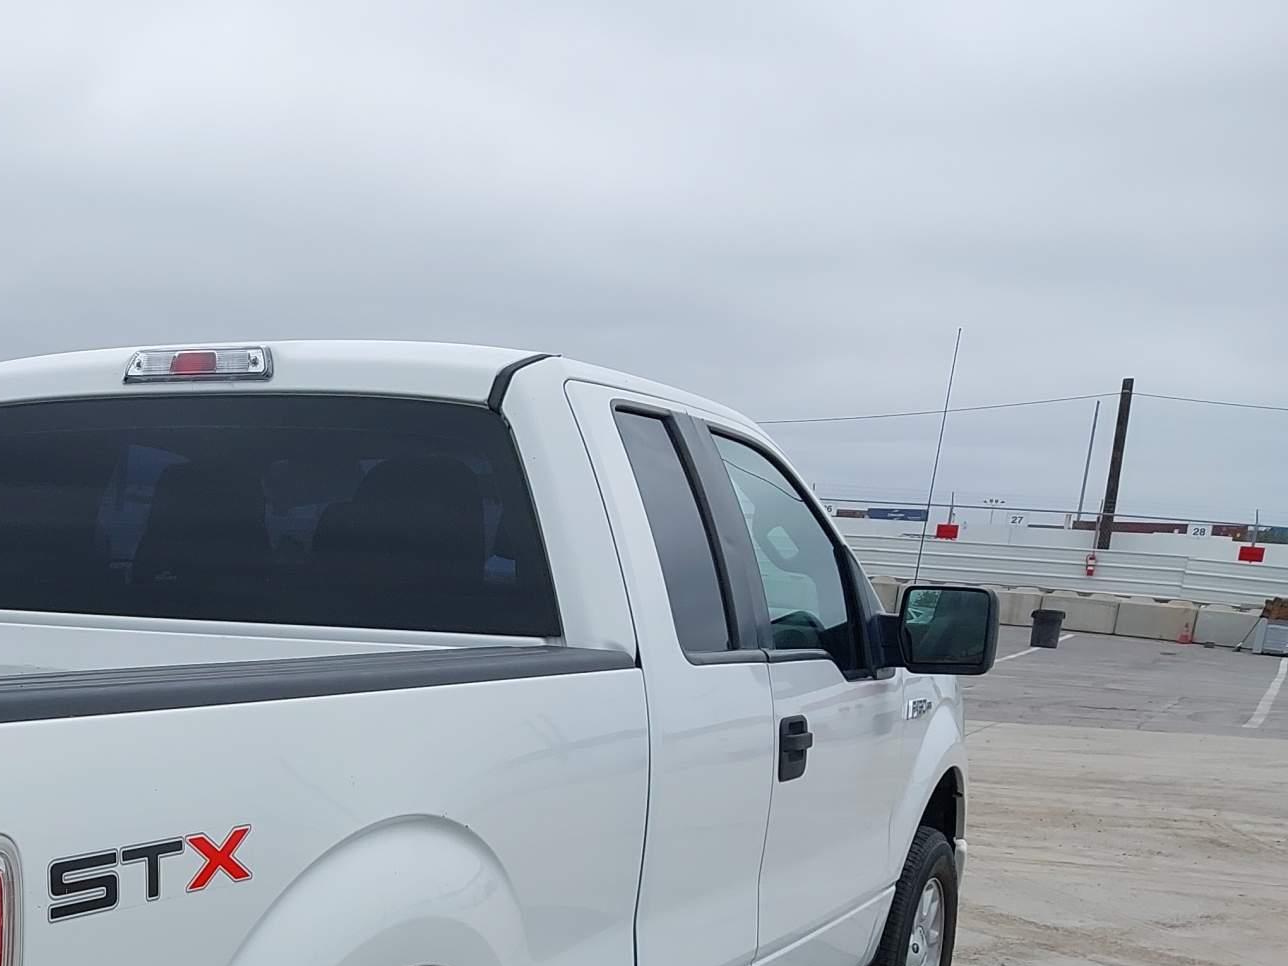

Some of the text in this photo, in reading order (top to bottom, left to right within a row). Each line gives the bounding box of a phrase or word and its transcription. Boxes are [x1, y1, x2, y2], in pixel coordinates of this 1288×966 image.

[1010, 516, 1024, 524] 27
[1192, 527, 1206, 536] 28
[48, 824, 252, 923] STX
